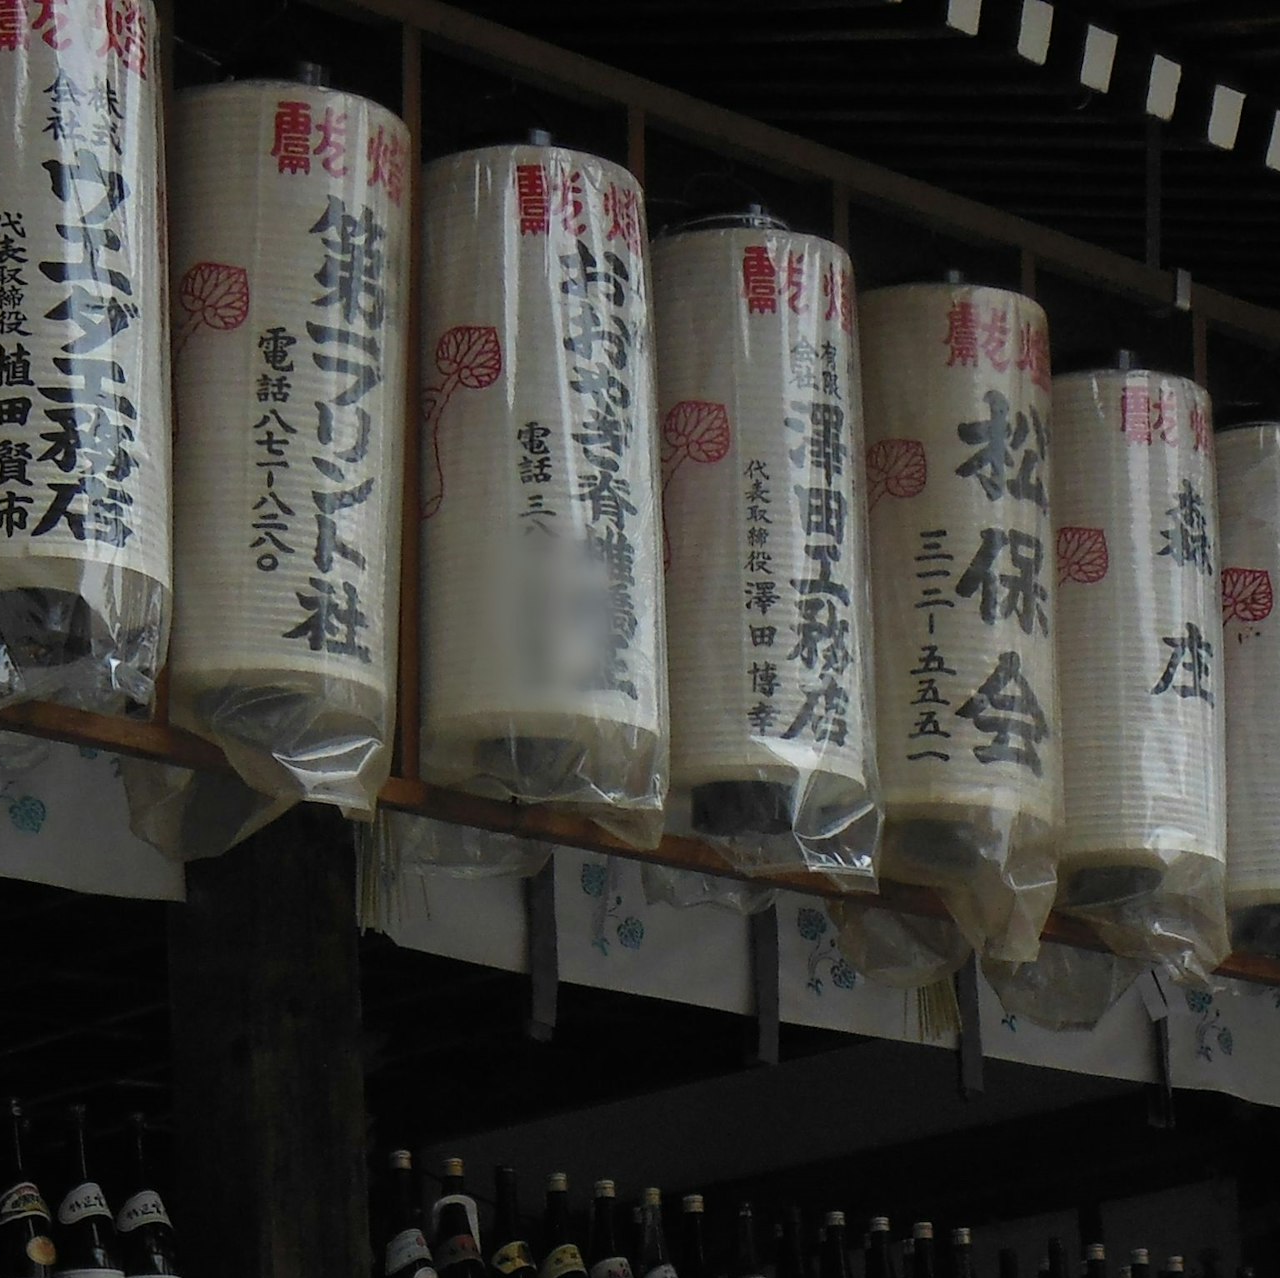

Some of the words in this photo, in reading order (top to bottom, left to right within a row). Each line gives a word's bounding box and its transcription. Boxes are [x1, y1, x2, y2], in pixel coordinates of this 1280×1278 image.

[30, 149, 141, 548] ウエダ工務店
[558, 239, 638, 700] おおやぎ脊椎
[782, 401, 855, 750] 澤田工務店
[955, 388, 1050, 780] 松保全
